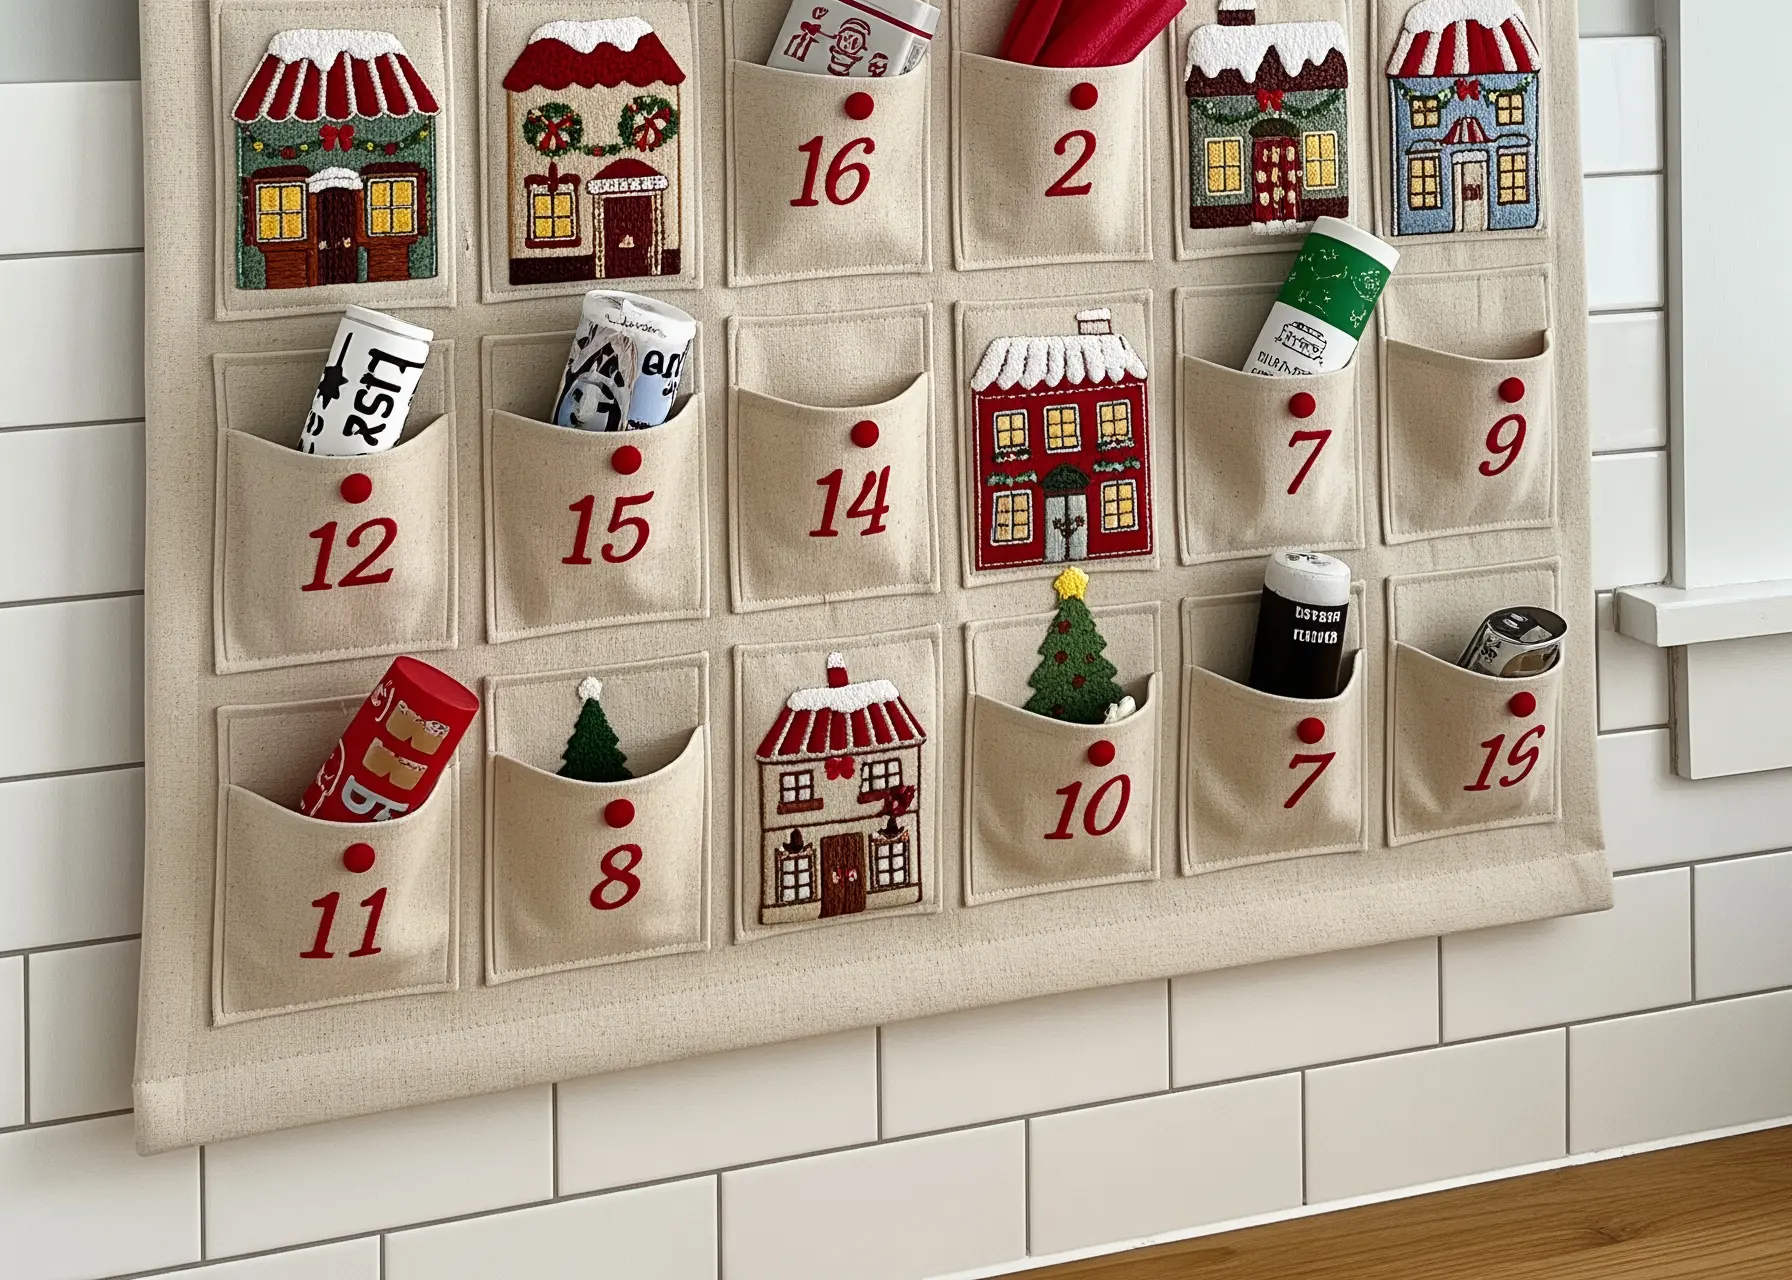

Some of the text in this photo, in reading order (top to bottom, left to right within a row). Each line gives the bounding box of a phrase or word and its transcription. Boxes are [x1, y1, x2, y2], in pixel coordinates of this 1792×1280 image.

[790, 136, 876, 207] 16
[1045, 129, 1096, 197] 2
[1287, 429, 1332, 495] 7
[1479, 414, 1527, 477] 9
[561, 491, 654, 565] 15
[808, 465, 891, 538] 14
[302, 517, 398, 592] 12
[1043, 774, 1131, 840] 10
[1284, 752, 1336, 809] 7
[589, 843, 643, 911] 8
[299, 888, 388, 959] 11
